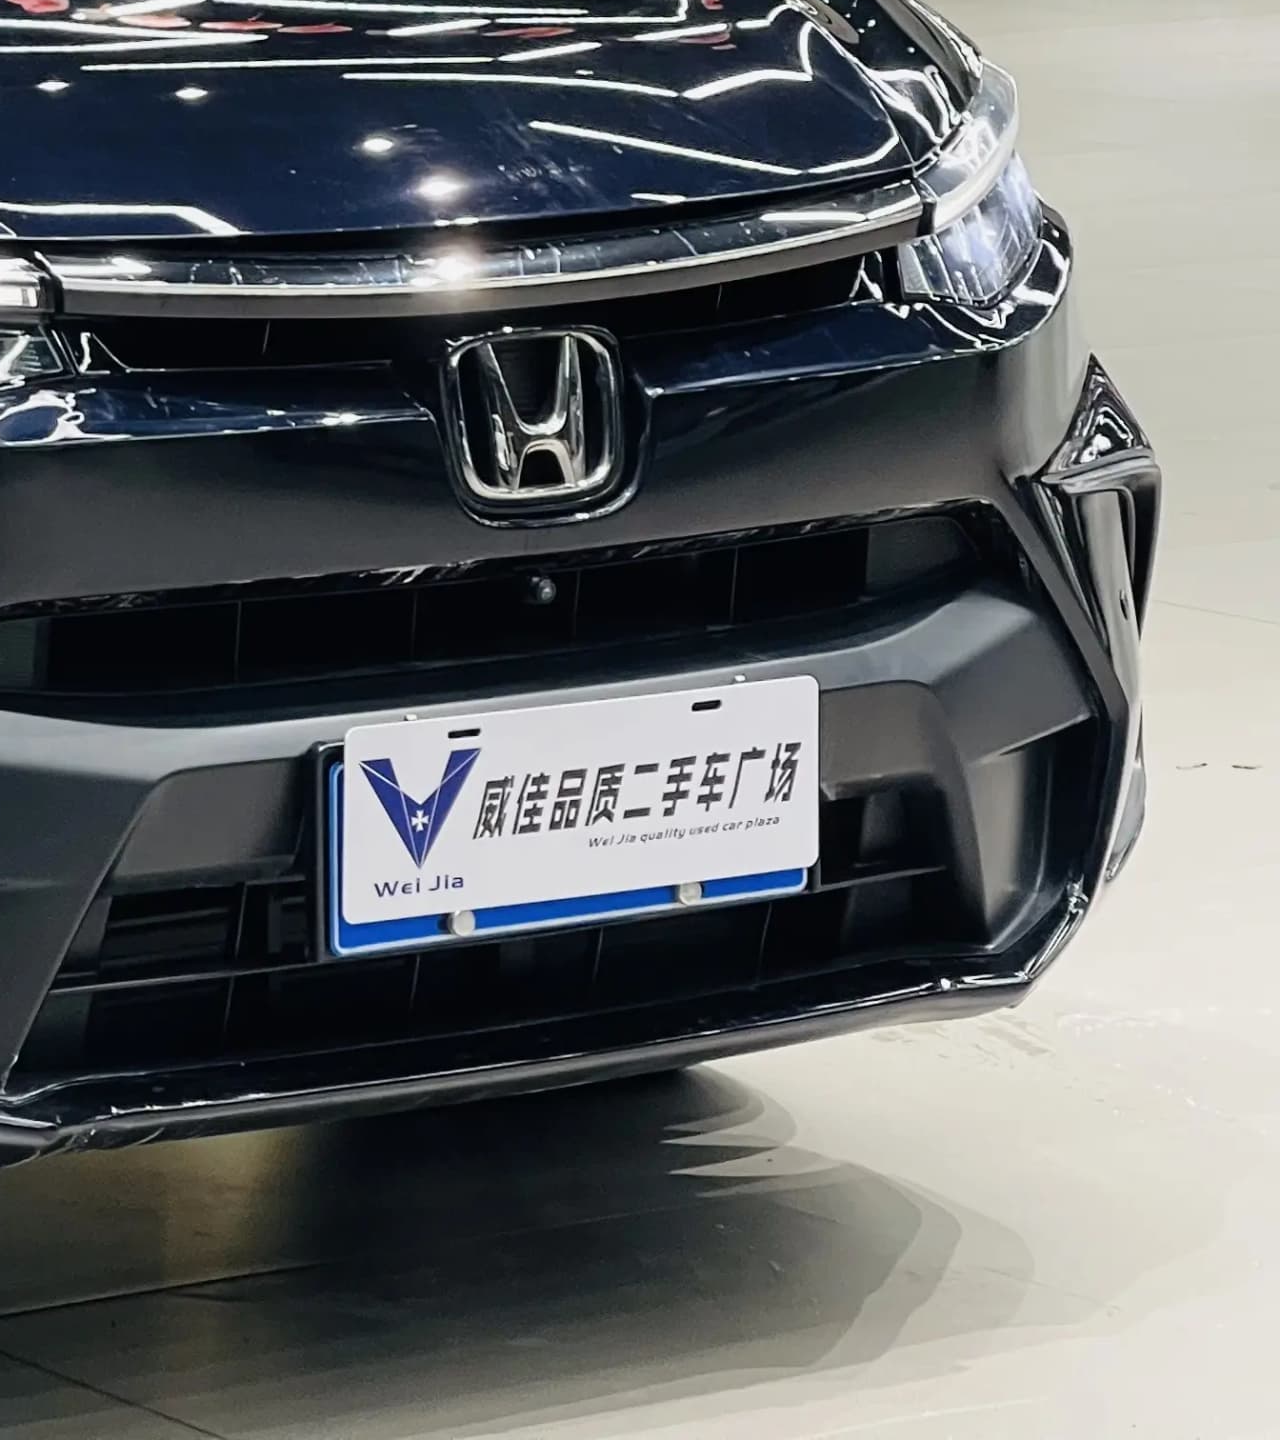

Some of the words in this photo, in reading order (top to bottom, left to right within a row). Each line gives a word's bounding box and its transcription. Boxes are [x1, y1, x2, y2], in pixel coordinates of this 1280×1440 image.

[473, 742, 802, 840] 威佳品质二手车广场
[588, 834, 615, 848] Wei
[617, 833, 637, 845] Jia
[639, 825, 686, 843] quality
[688, 823, 720, 837] used
[722, 821, 743, 832] car
[744, 815, 781, 831] plaza
[374, 877, 421, 898] Wei
[428, 874, 465, 892] Jia
